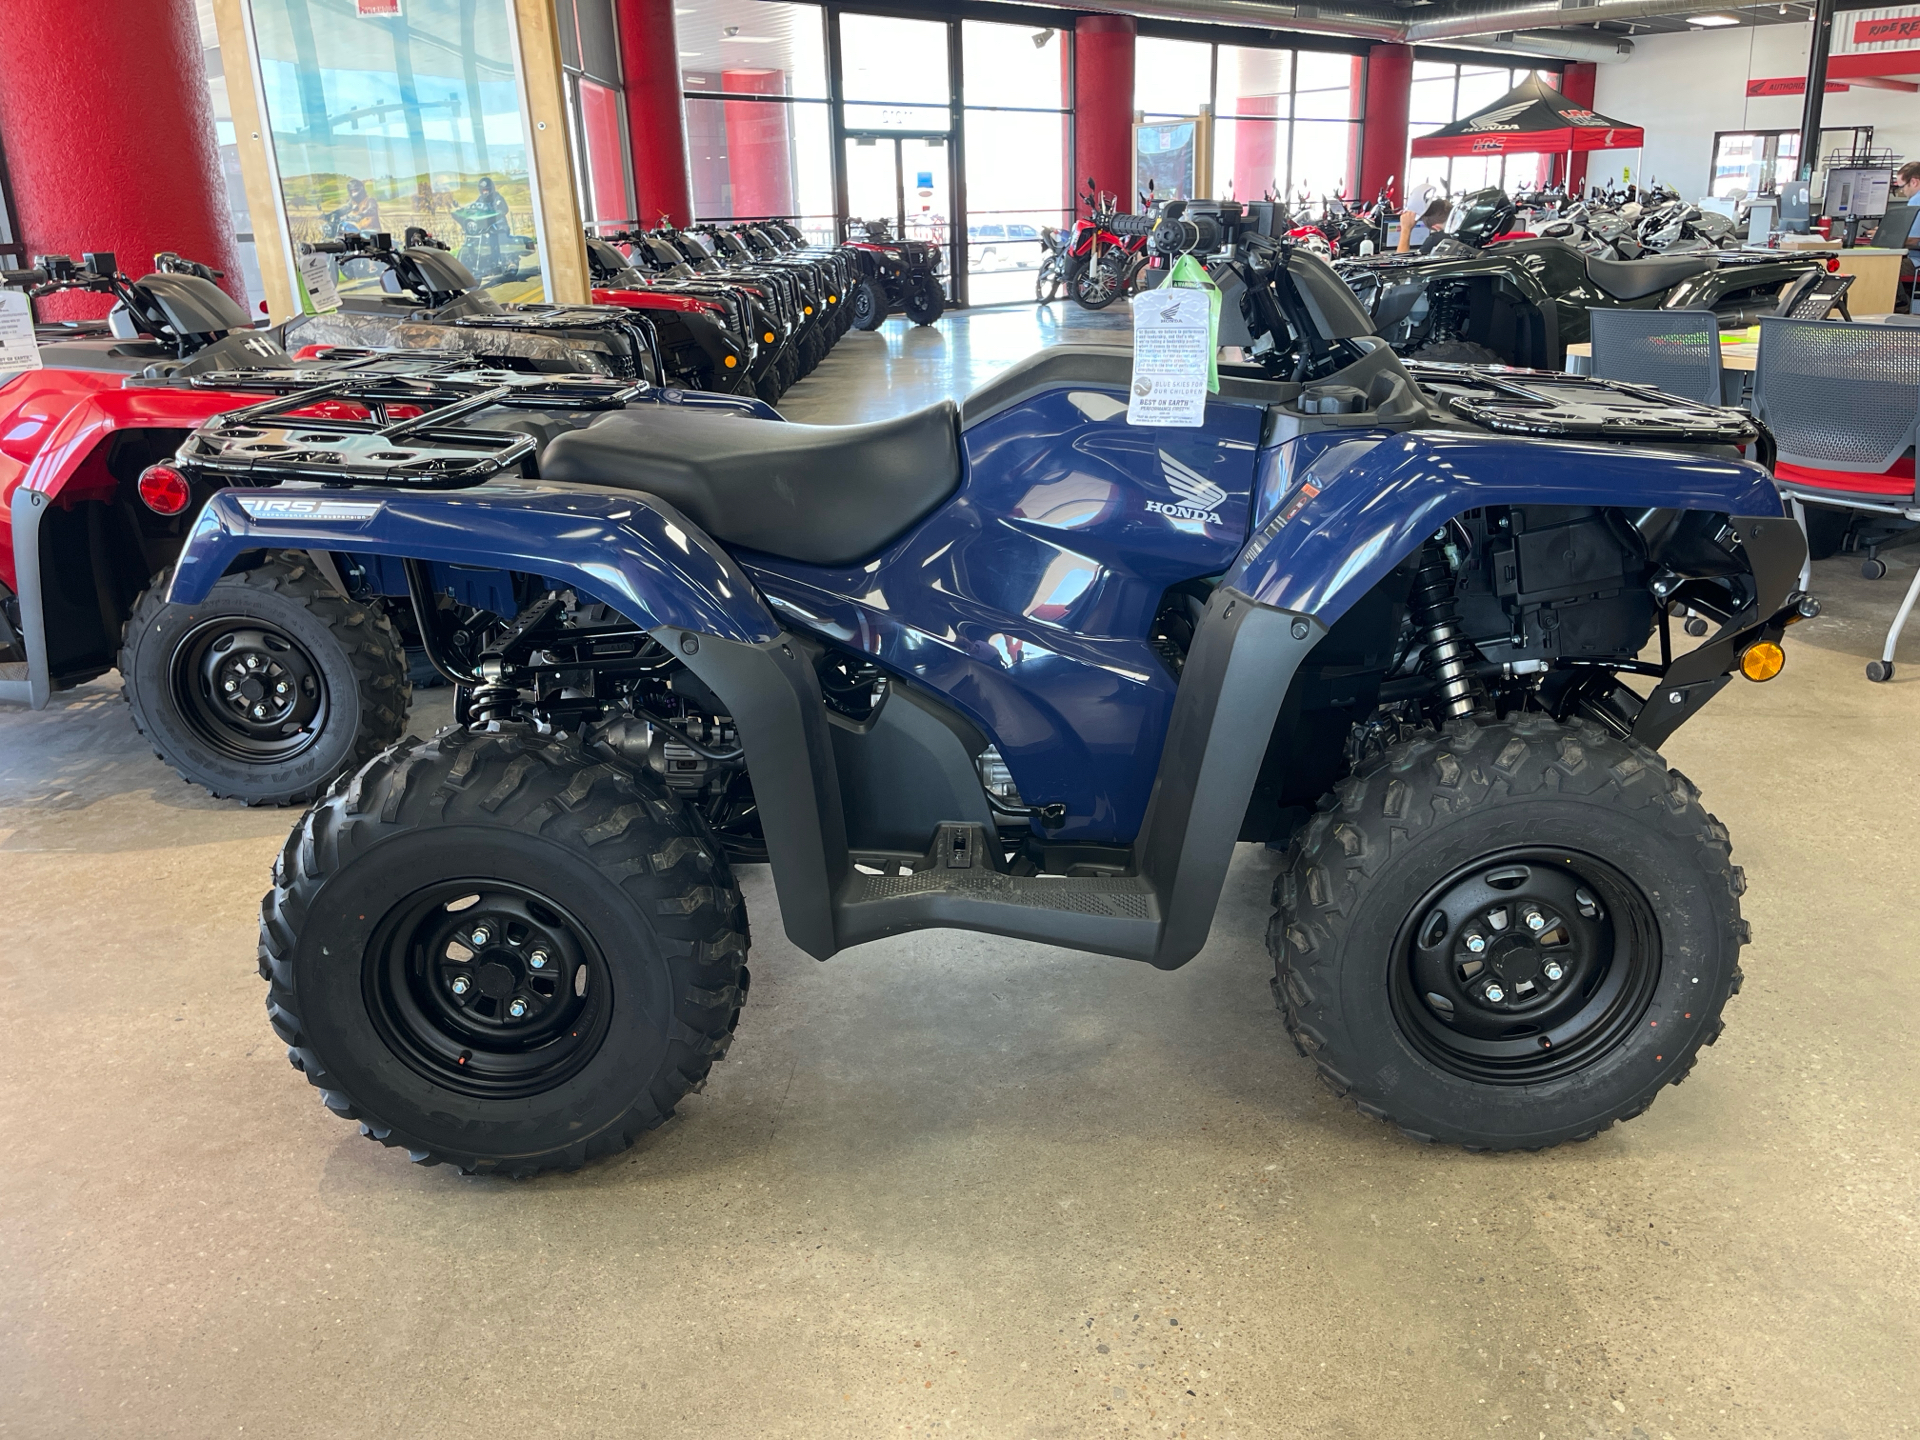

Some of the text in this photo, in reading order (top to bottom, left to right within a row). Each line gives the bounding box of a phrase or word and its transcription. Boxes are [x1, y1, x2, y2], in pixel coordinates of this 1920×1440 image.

[1868, 20, 1920, 36] RIDE RE
[1768, 81, 1806, 91] AUTHORIZ
[1461, 124, 1520, 133] HONDA
[1472, 137, 1507, 152] HRC
[253, 501, 317, 512] IRS
[1144, 500, 1223, 525] HONDA
